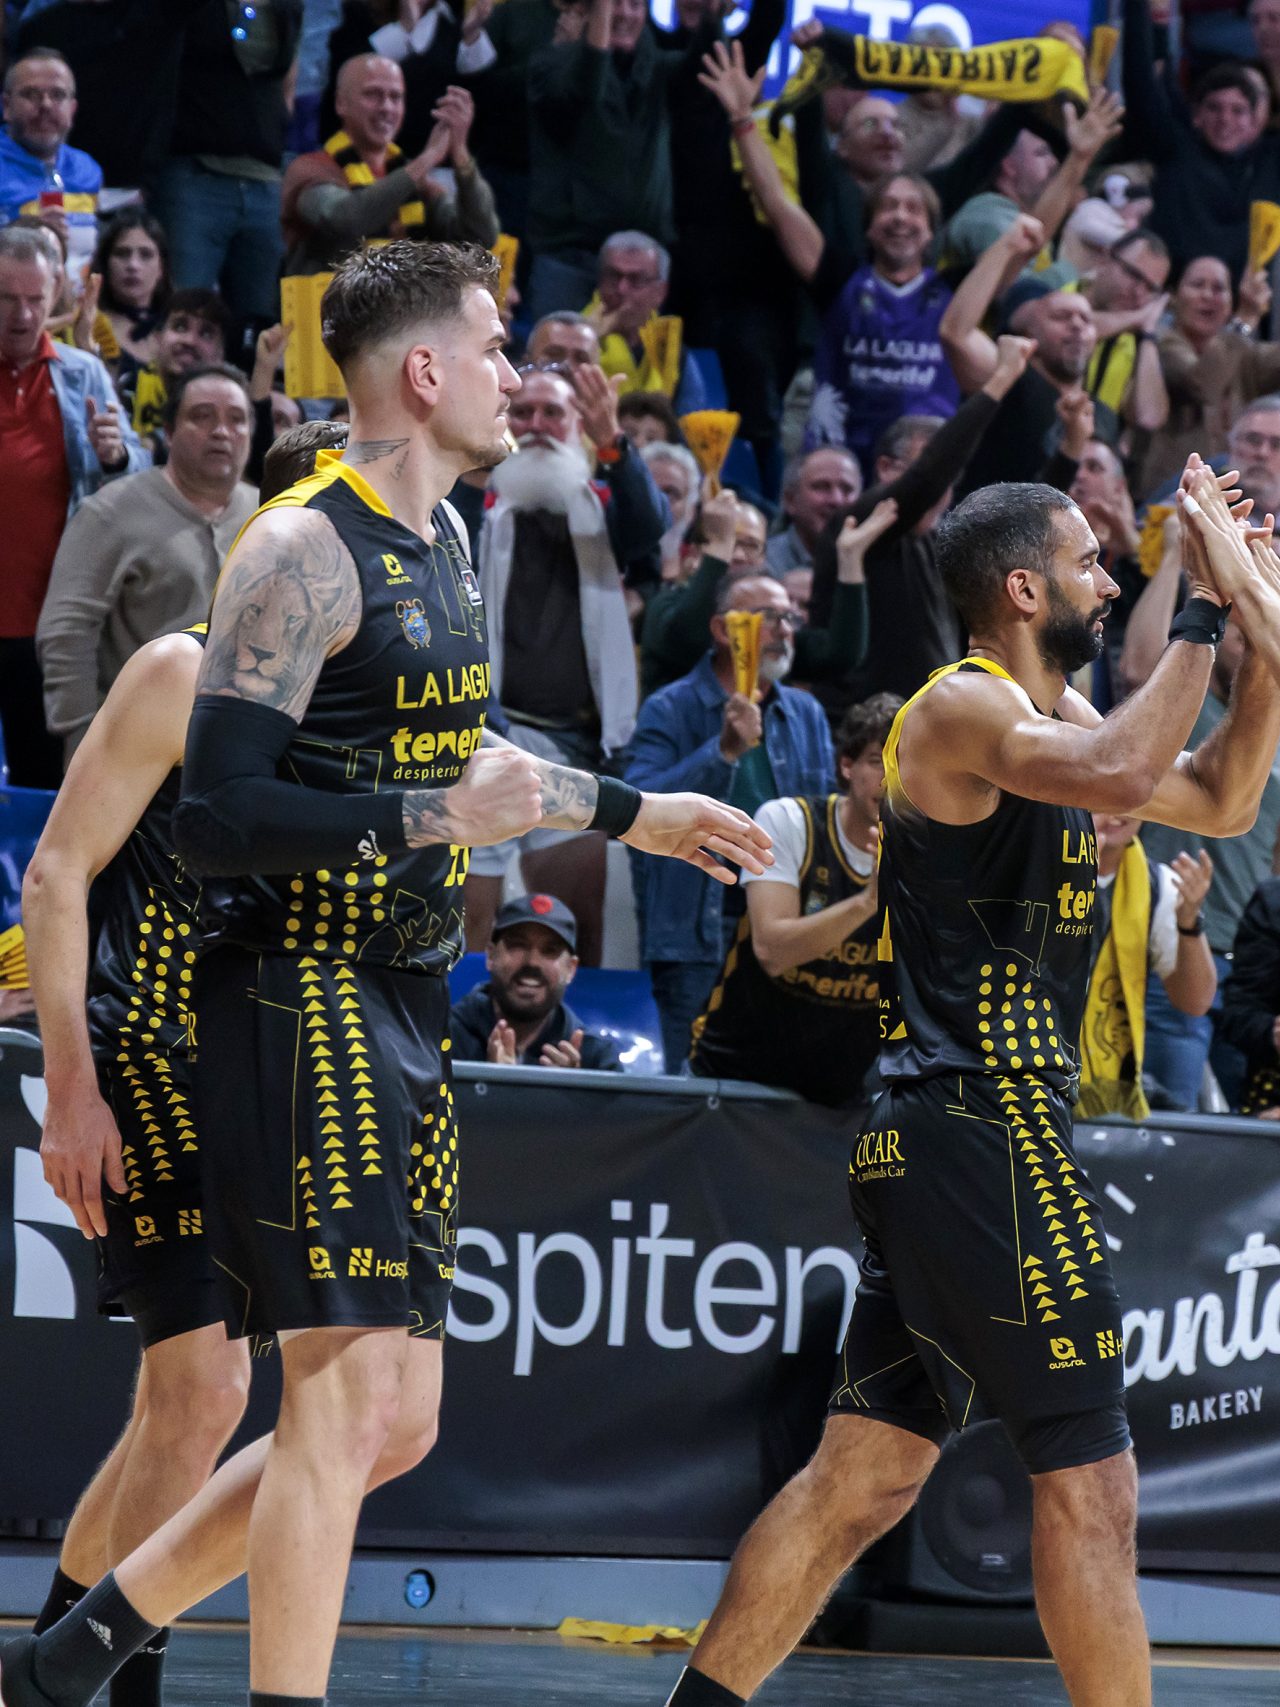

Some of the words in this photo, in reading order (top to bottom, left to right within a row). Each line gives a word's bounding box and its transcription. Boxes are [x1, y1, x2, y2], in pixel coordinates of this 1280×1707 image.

[396, 671, 443, 709] LA
[446, 662, 491, 703] LAGU
[390, 711, 487, 763] teneri
[393, 764, 460, 781] despierta
[1061, 829, 1099, 866] LAG
[1057, 879, 1096, 919] ten
[887, 1164, 906, 1178] Car
[445, 1200, 862, 1377] spiten
[1170, 1385, 1263, 1431] BAKERY
